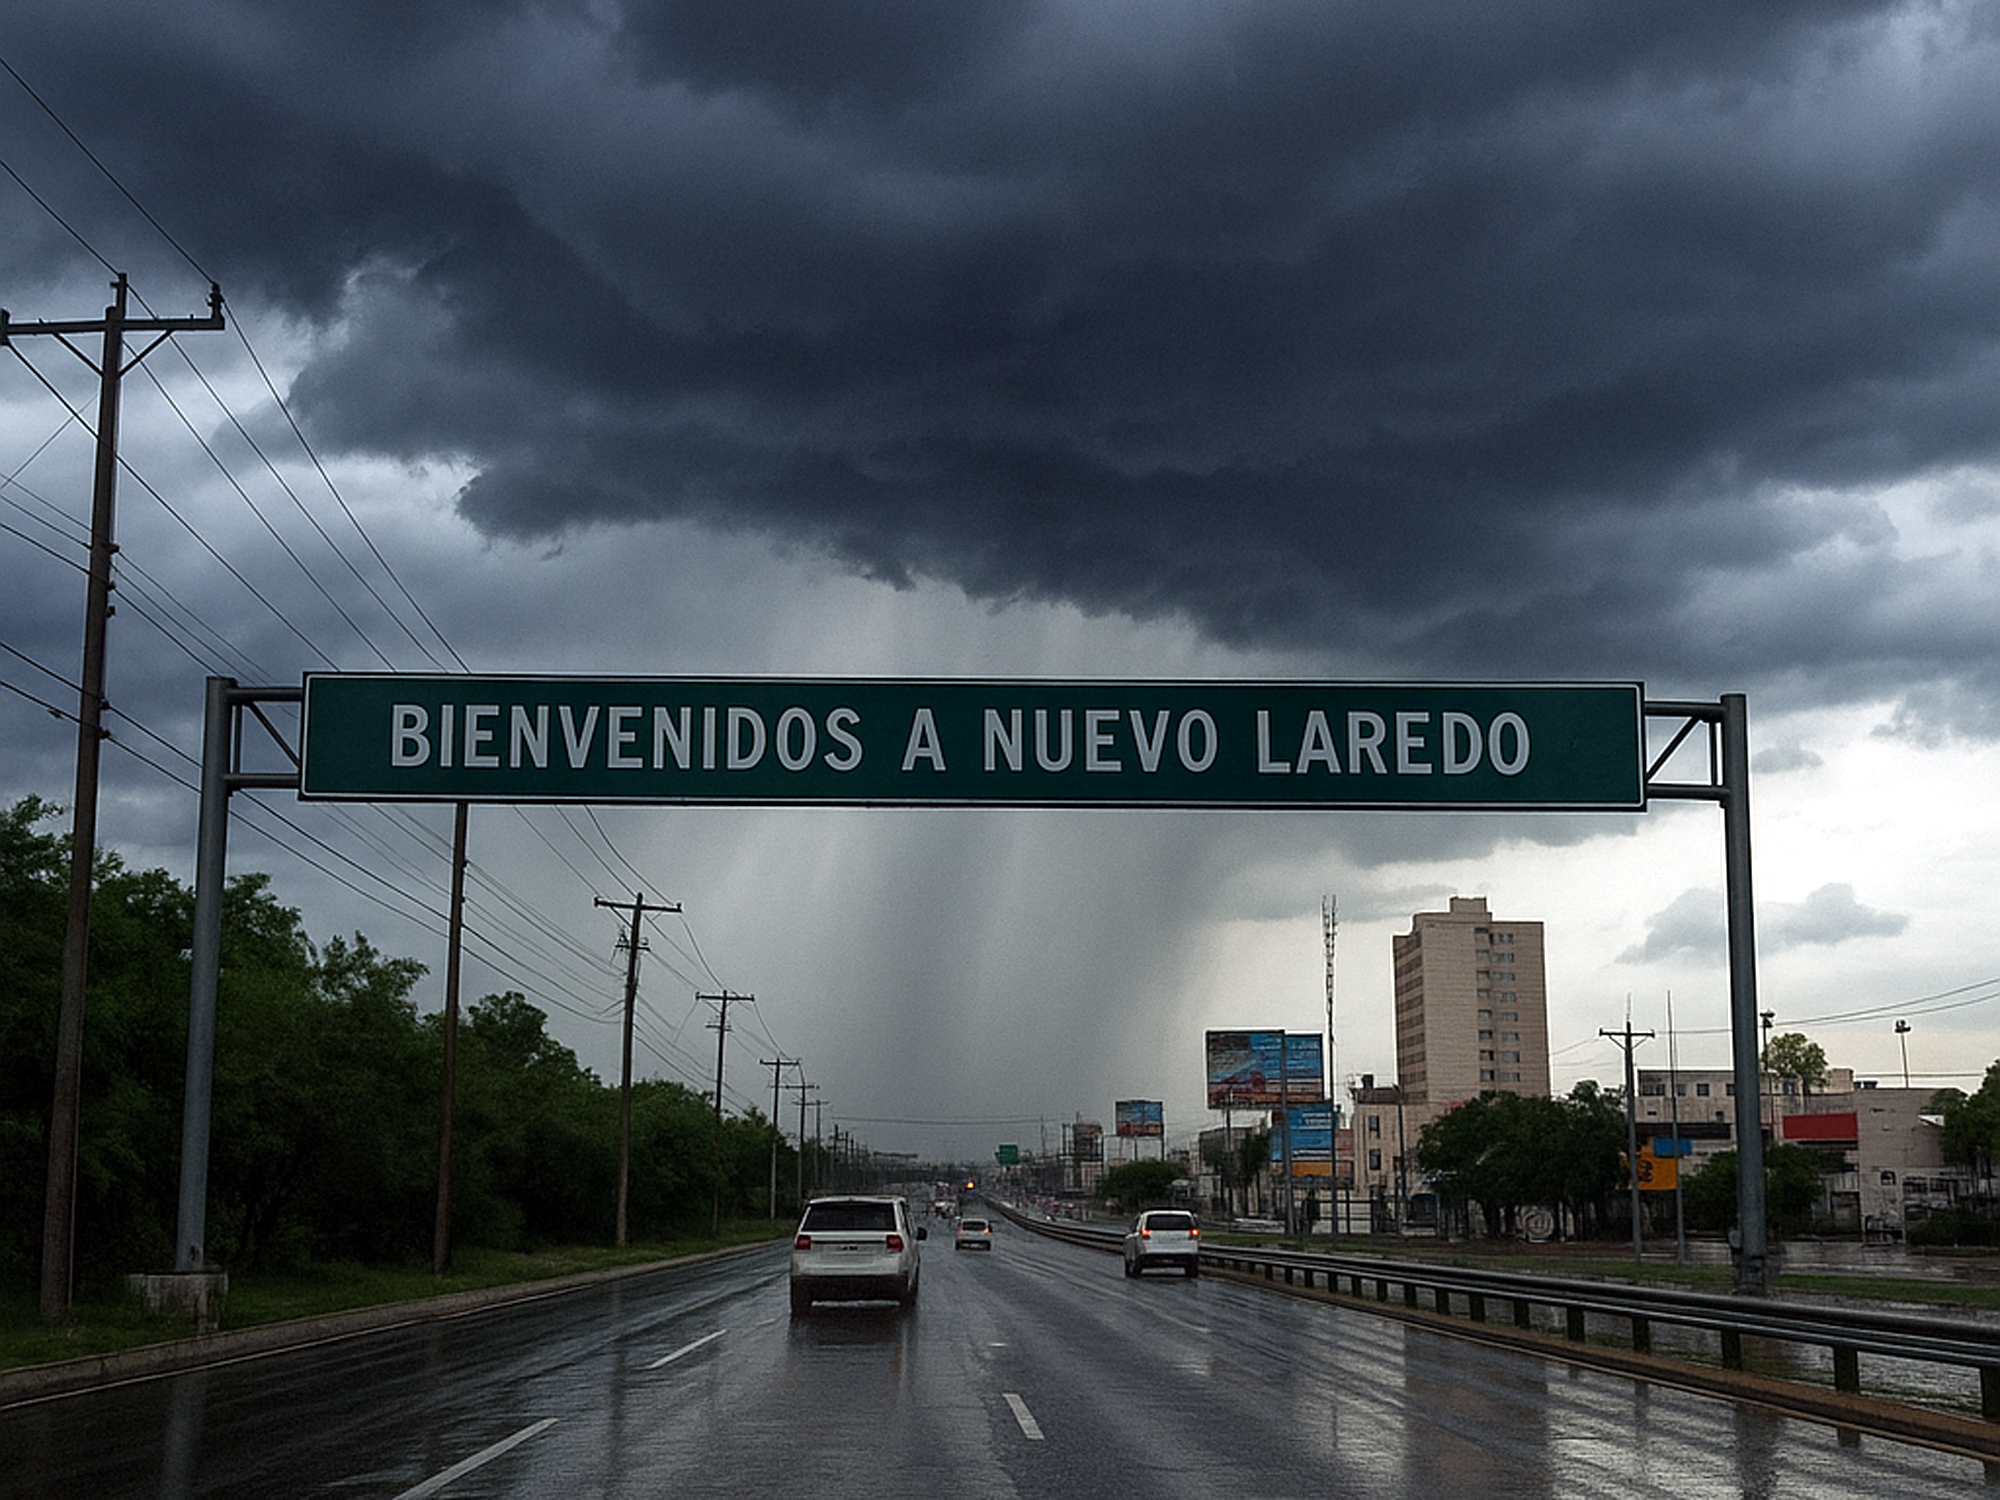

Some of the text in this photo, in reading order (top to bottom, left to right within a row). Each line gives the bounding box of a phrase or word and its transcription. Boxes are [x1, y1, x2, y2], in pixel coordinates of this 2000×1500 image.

[391, 703, 1532, 776] BIENVENIDOS A NUEVO LAREDO
